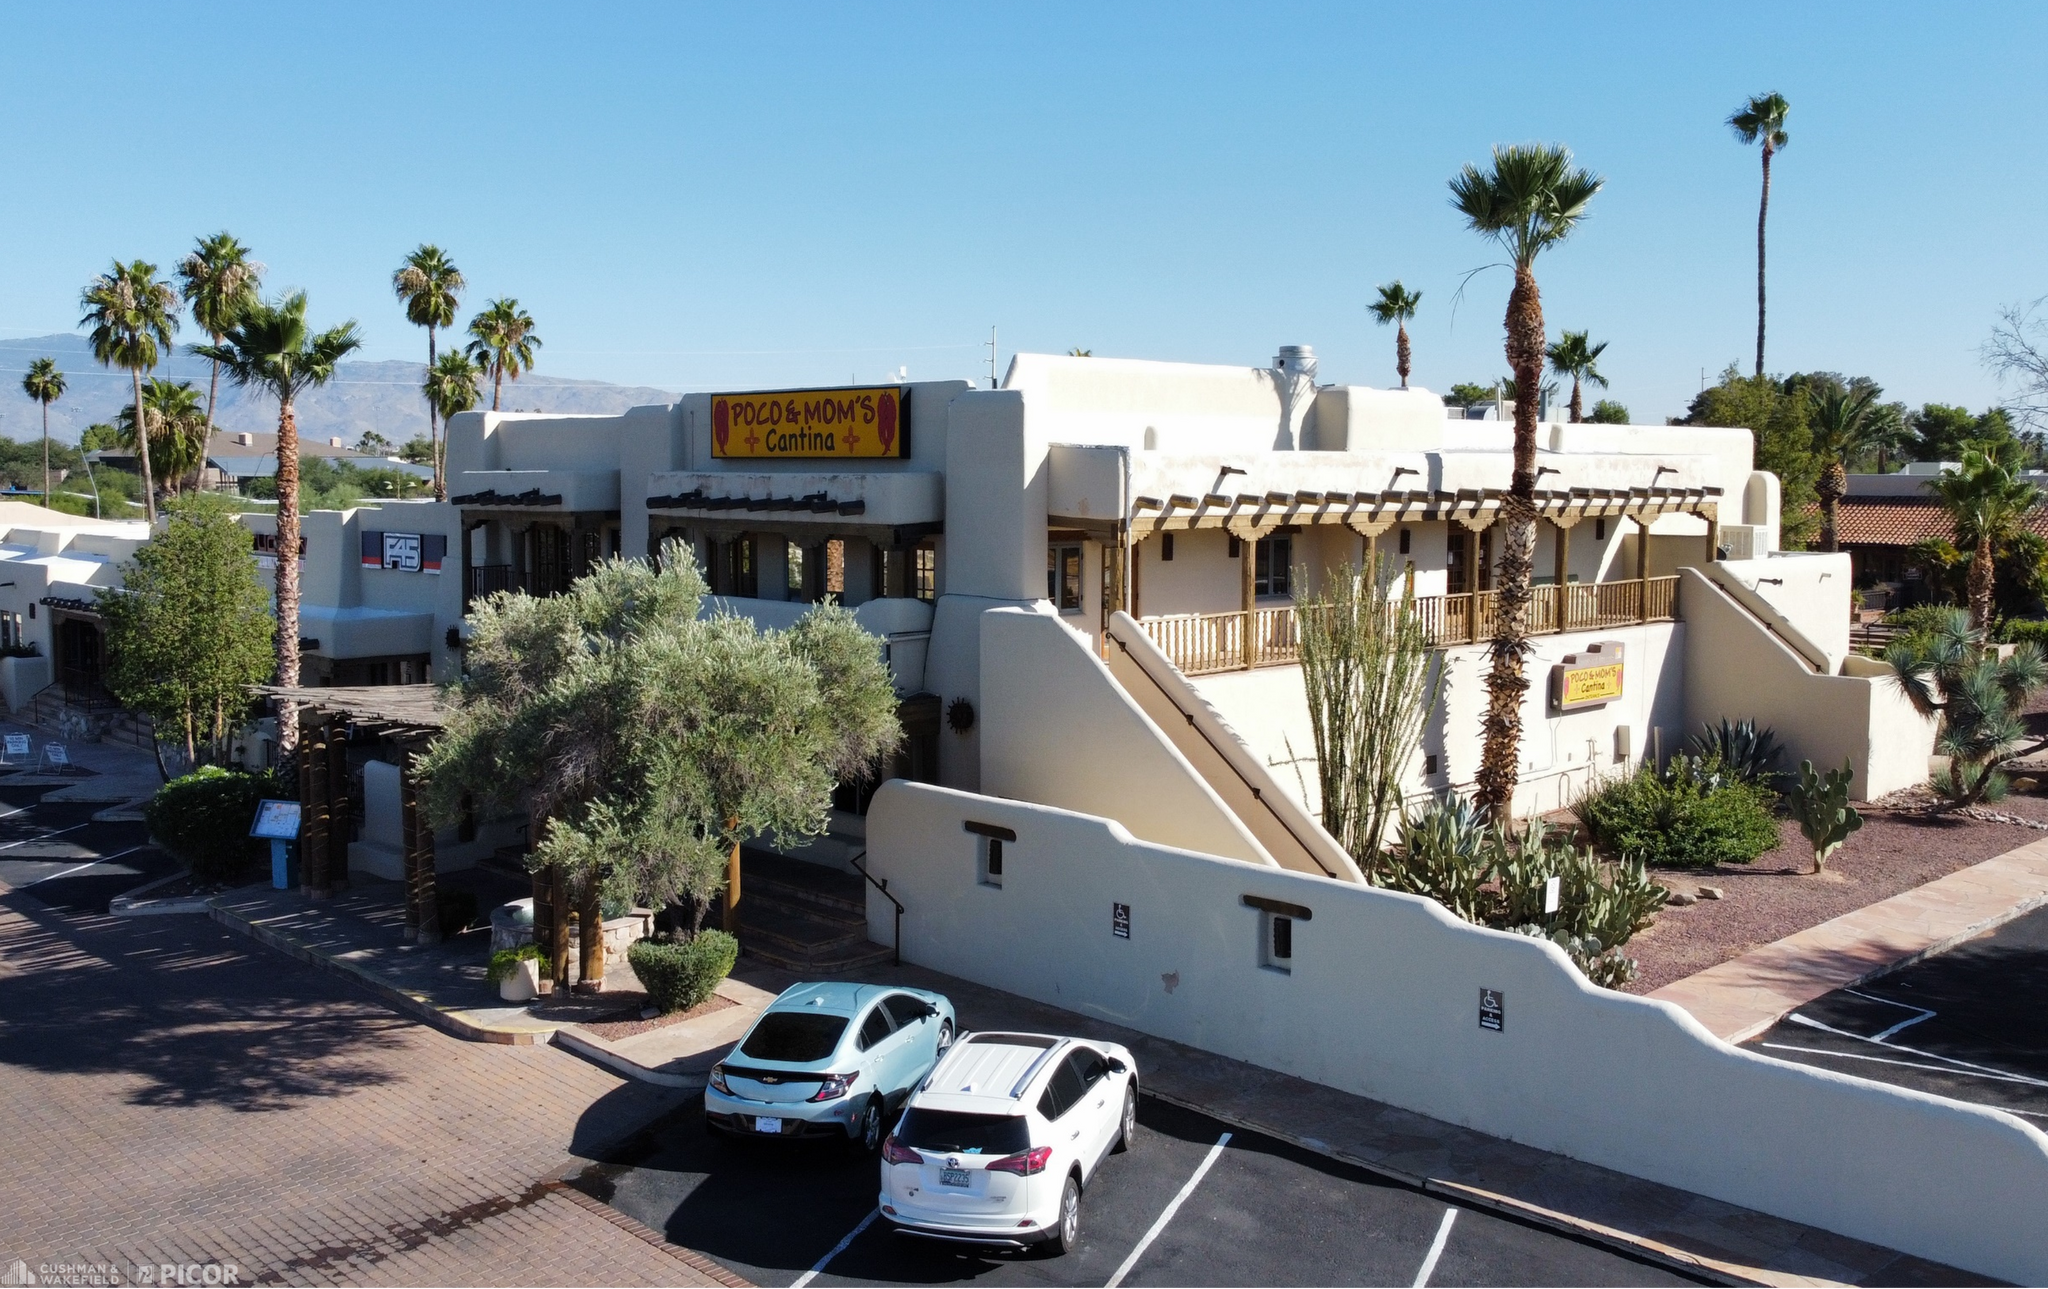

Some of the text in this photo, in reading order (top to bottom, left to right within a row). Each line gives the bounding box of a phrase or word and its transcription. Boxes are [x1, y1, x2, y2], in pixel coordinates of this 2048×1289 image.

[731, 395, 876, 427] POCO & MOM'S
[765, 425, 835, 452] Cantina
[383, 533, 421, 572] F45
[1570, 666, 1617, 684] POCO & MOM'S
[1581, 681, 1605, 693] Cantina
[1481, 1006, 1501, 1015] PARKING
